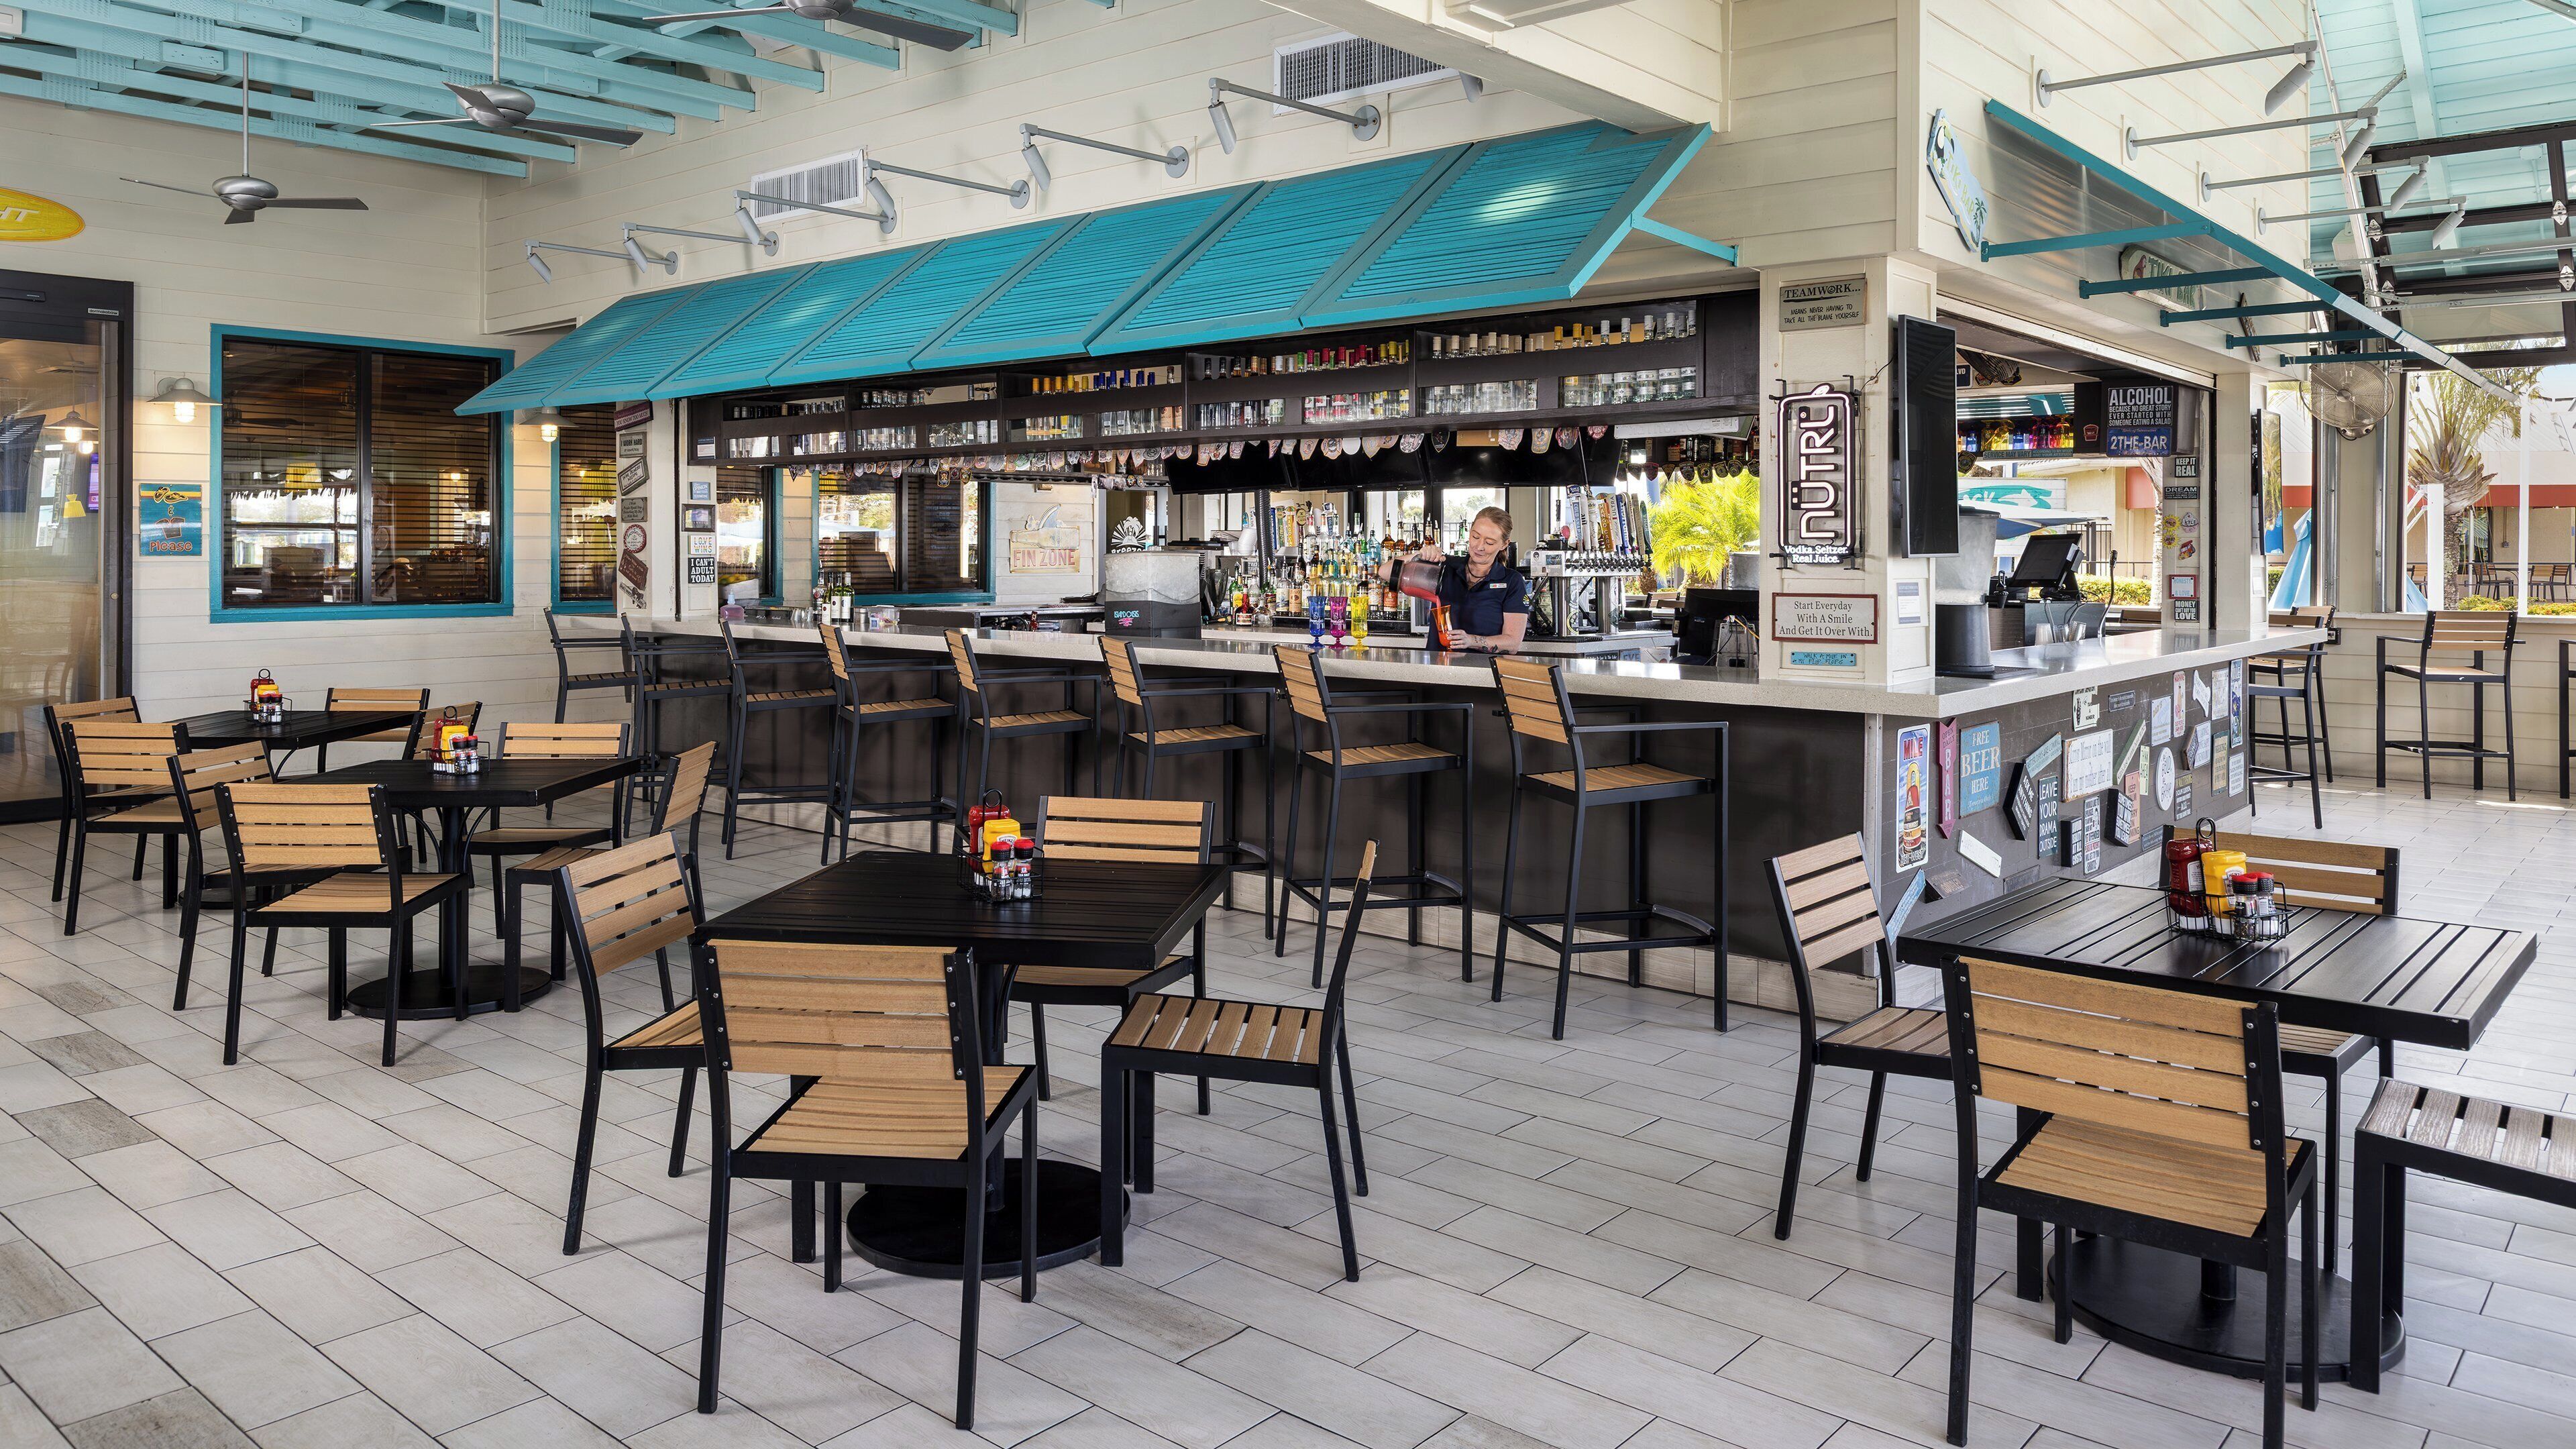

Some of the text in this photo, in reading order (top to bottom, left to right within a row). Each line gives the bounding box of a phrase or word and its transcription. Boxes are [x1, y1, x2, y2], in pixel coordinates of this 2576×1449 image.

[1946, 152, 1974, 216] TIKI BAR
[1835, 311, 1860, 319] YOURSELF
[2109, 388, 2171, 406] ALCOHOL
[2110, 435, 2167, 450] 2THE-BAR
[2176, 466, 2196, 476] REAL
[168, 505, 174, 517] &
[1599, 504, 1607, 528] MANGO
[150, 540, 193, 551] Please
[694, 537, 712, 545] LOVE
[694, 545, 712, 553] WINS
[691, 558, 714, 567] I CAN'T
[1013, 549, 1075, 568] FIN ZONE
[1792, 554, 1840, 564] Real Juice.
[690, 566, 714, 574] ADULT
[691, 575, 714, 583] TODAY
[1794, 601, 1852, 612] Start Everyday
[1796, 613, 1853, 623] With A Smile
[1779, 625, 1873, 636] And Get It Over With.
[1943, 727, 1954, 740] OPEN
[1972, 730, 1990, 747] FREE
[1903, 737, 1923, 760] MILE
[1943, 736, 1955, 749] DAILY
[1961, 746, 2000, 778] BEER
[1972, 776, 1989, 795] HERE
[2039, 781, 2058, 800] LEAVE
[2128, 784, 2136, 794] KEEP
[2017, 784, 2032, 818] ANYTHING
[2028, 790, 2035, 802] ME
[2039, 801, 2057, 820] YOUR
[2039, 820, 2057, 837] DRAMA
[2039, 837, 2057, 853] OUTSIDE
